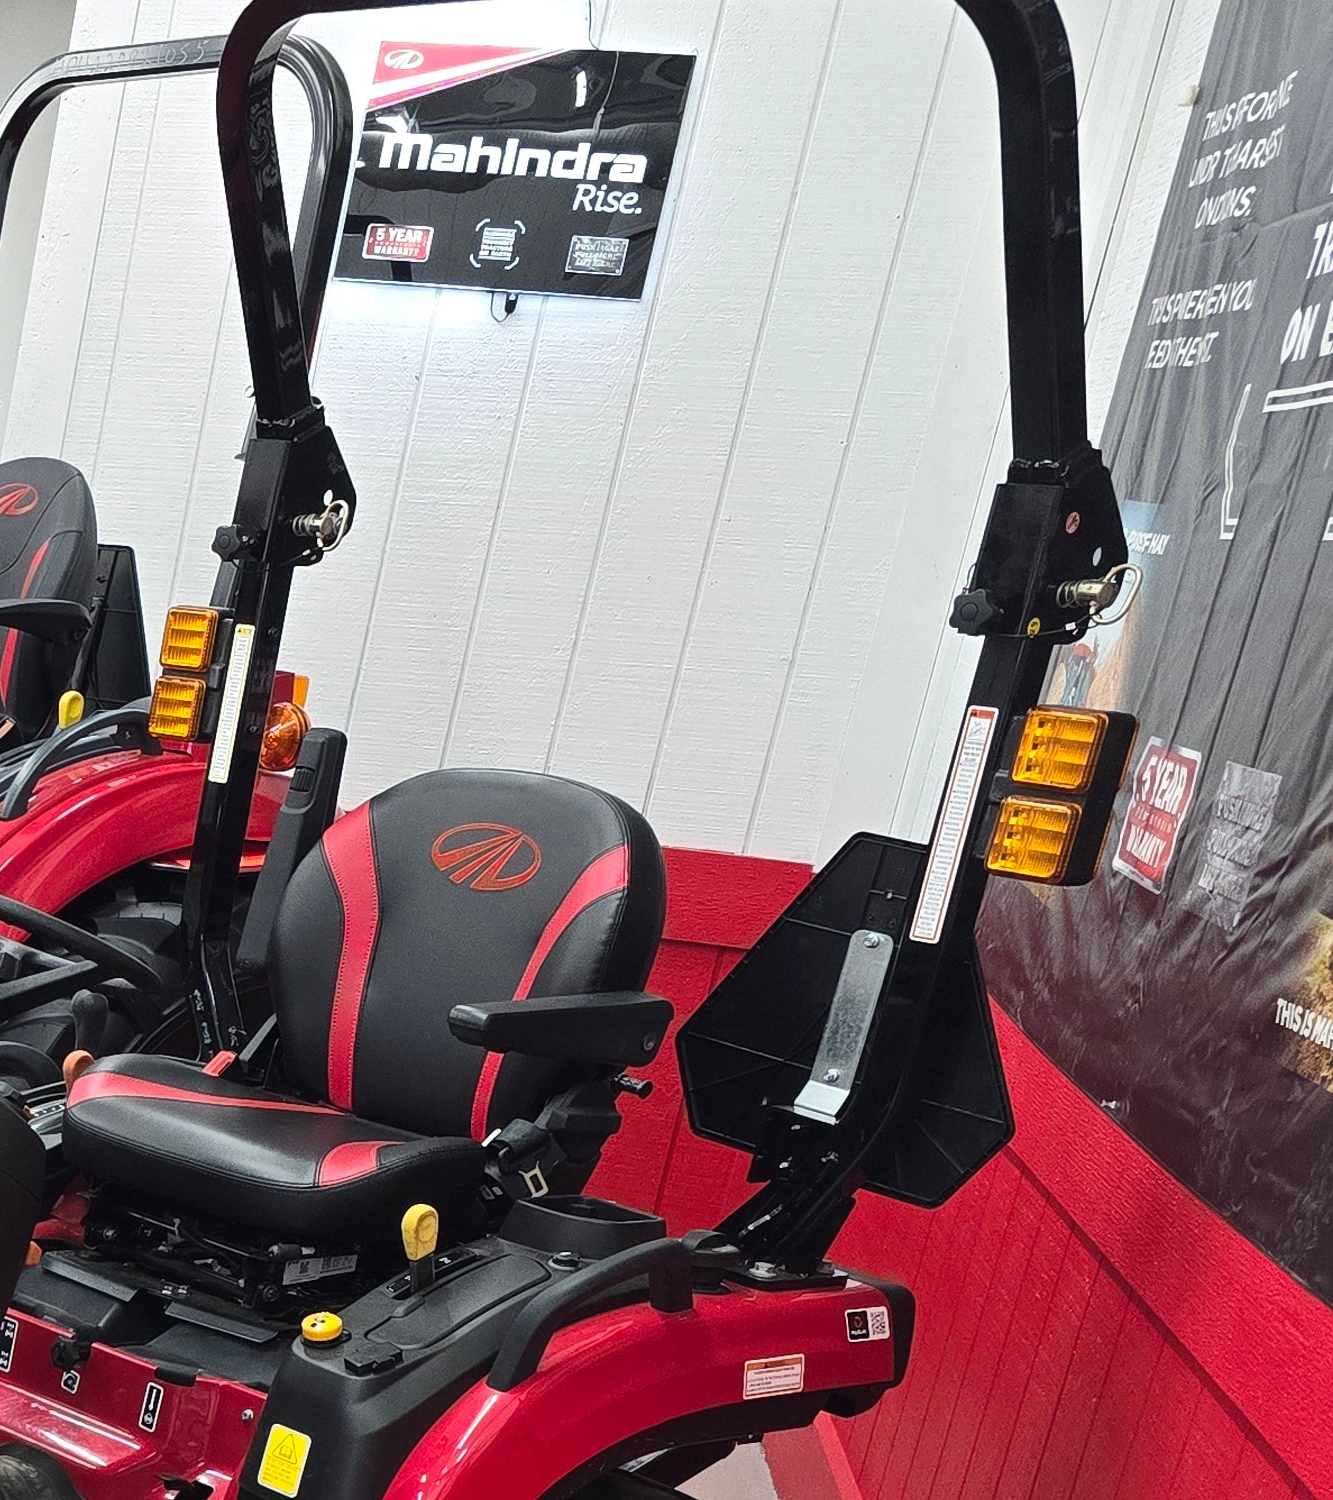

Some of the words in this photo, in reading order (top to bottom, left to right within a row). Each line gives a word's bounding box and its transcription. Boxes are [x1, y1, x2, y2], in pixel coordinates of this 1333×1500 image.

[573, 183, 643, 216] Rise.
[376, 227, 387, 241] 5
[389, 228, 423, 243] YEAR
[1275, 998, 1303, 1033] THIS
[1299, 1009, 1315, 1038] IS
